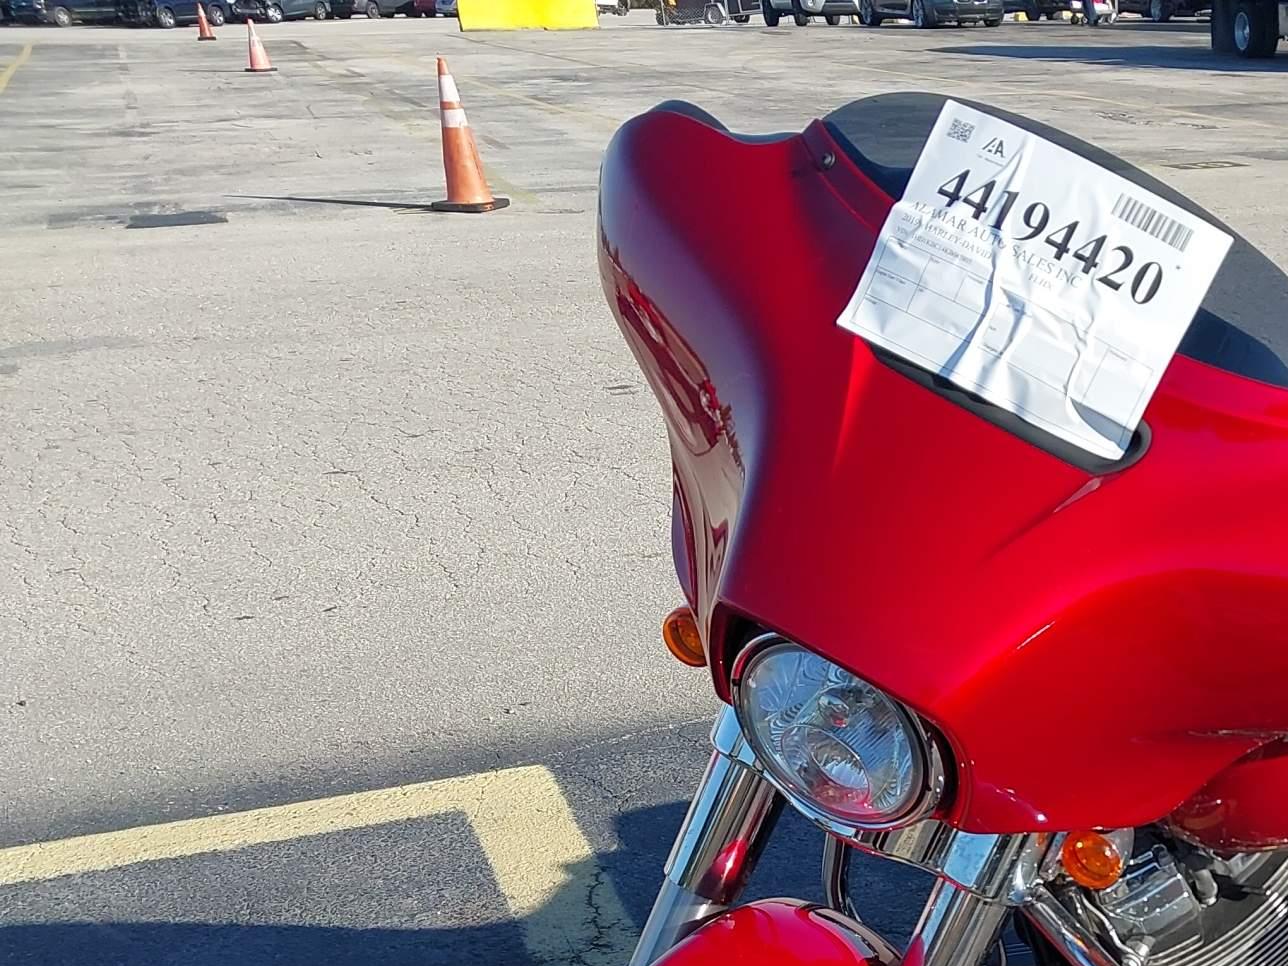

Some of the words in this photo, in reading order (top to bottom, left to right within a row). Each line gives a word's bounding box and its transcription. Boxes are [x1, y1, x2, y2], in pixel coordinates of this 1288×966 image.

[938, 168, 1163, 305] 44194420
[1010, 245, 1056, 275] SALES
[1055, 268, 1083, 289] INC
